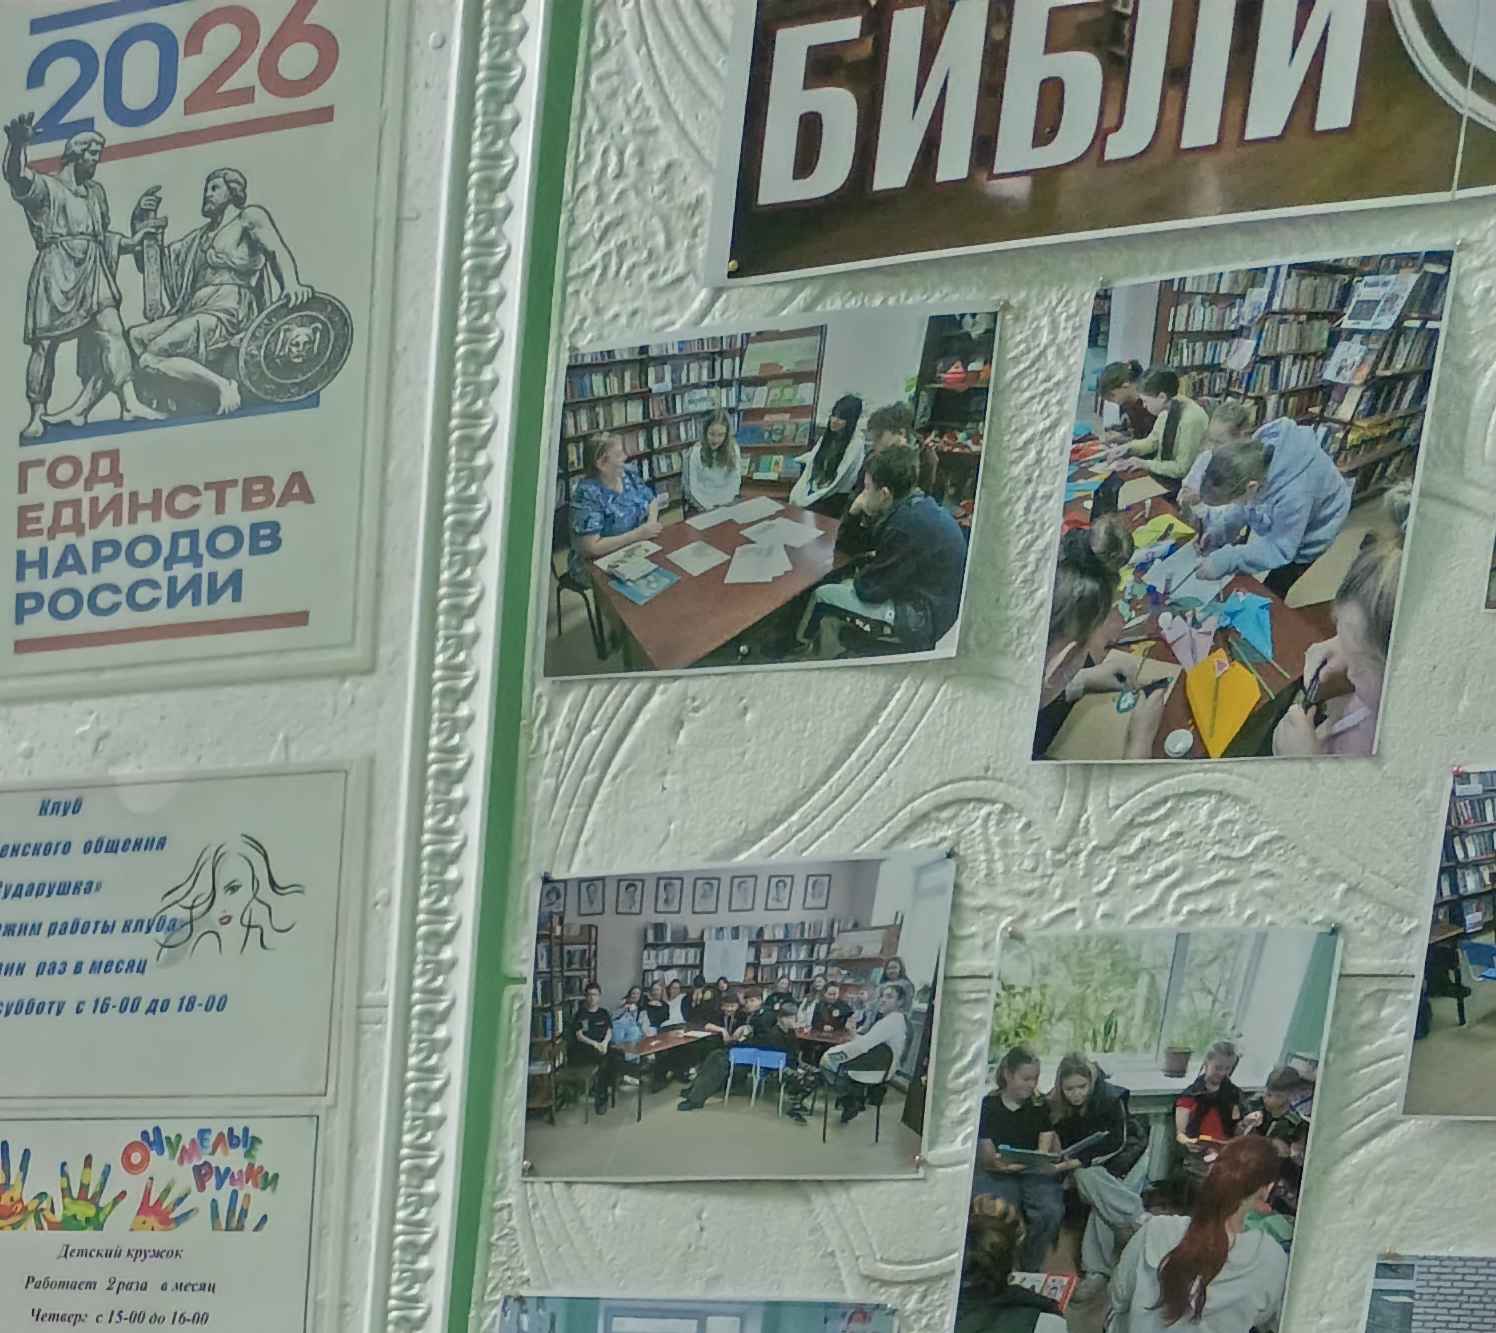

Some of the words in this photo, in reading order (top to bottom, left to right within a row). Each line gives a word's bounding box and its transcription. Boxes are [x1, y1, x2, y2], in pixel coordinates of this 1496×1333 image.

[26, 0, 340, 146] 2026
[17, 449, 124, 495] ГОД
[16, 471, 315, 540] ЕДИНСТВА
[15, 520, 282, 582] НАРОДОВ
[14, 568, 244, 625] РОССИИ
[38, 797, 84, 817] Клуб
[83, 836, 167, 856] общения
[47, 919, 116, 938] работы
[35, 960, 67, 978] раз
[73, 961, 83, 975] в
[89, 959, 148, 977] месяц
[75, 1000, 86, 1015] с
[144, 998, 171, 1017] до
[177, 994, 228, 1014] 18-00
[57, 1244, 122, 1260] Детский
[126, 1246, 184, 1262] кружок
[25, 1275, 97, 1291] Работает
[160, 1281, 168, 1292] в
[171, 1282, 216, 1295] месяц
[31, 1308, 88, 1326] Четверг
[95, 1313, 104, 1324] с
[107, 1310, 146, 1325] 15-00
[148, 1310, 166, 1325] до
[171, 1311, 210, 1326] 16-00
